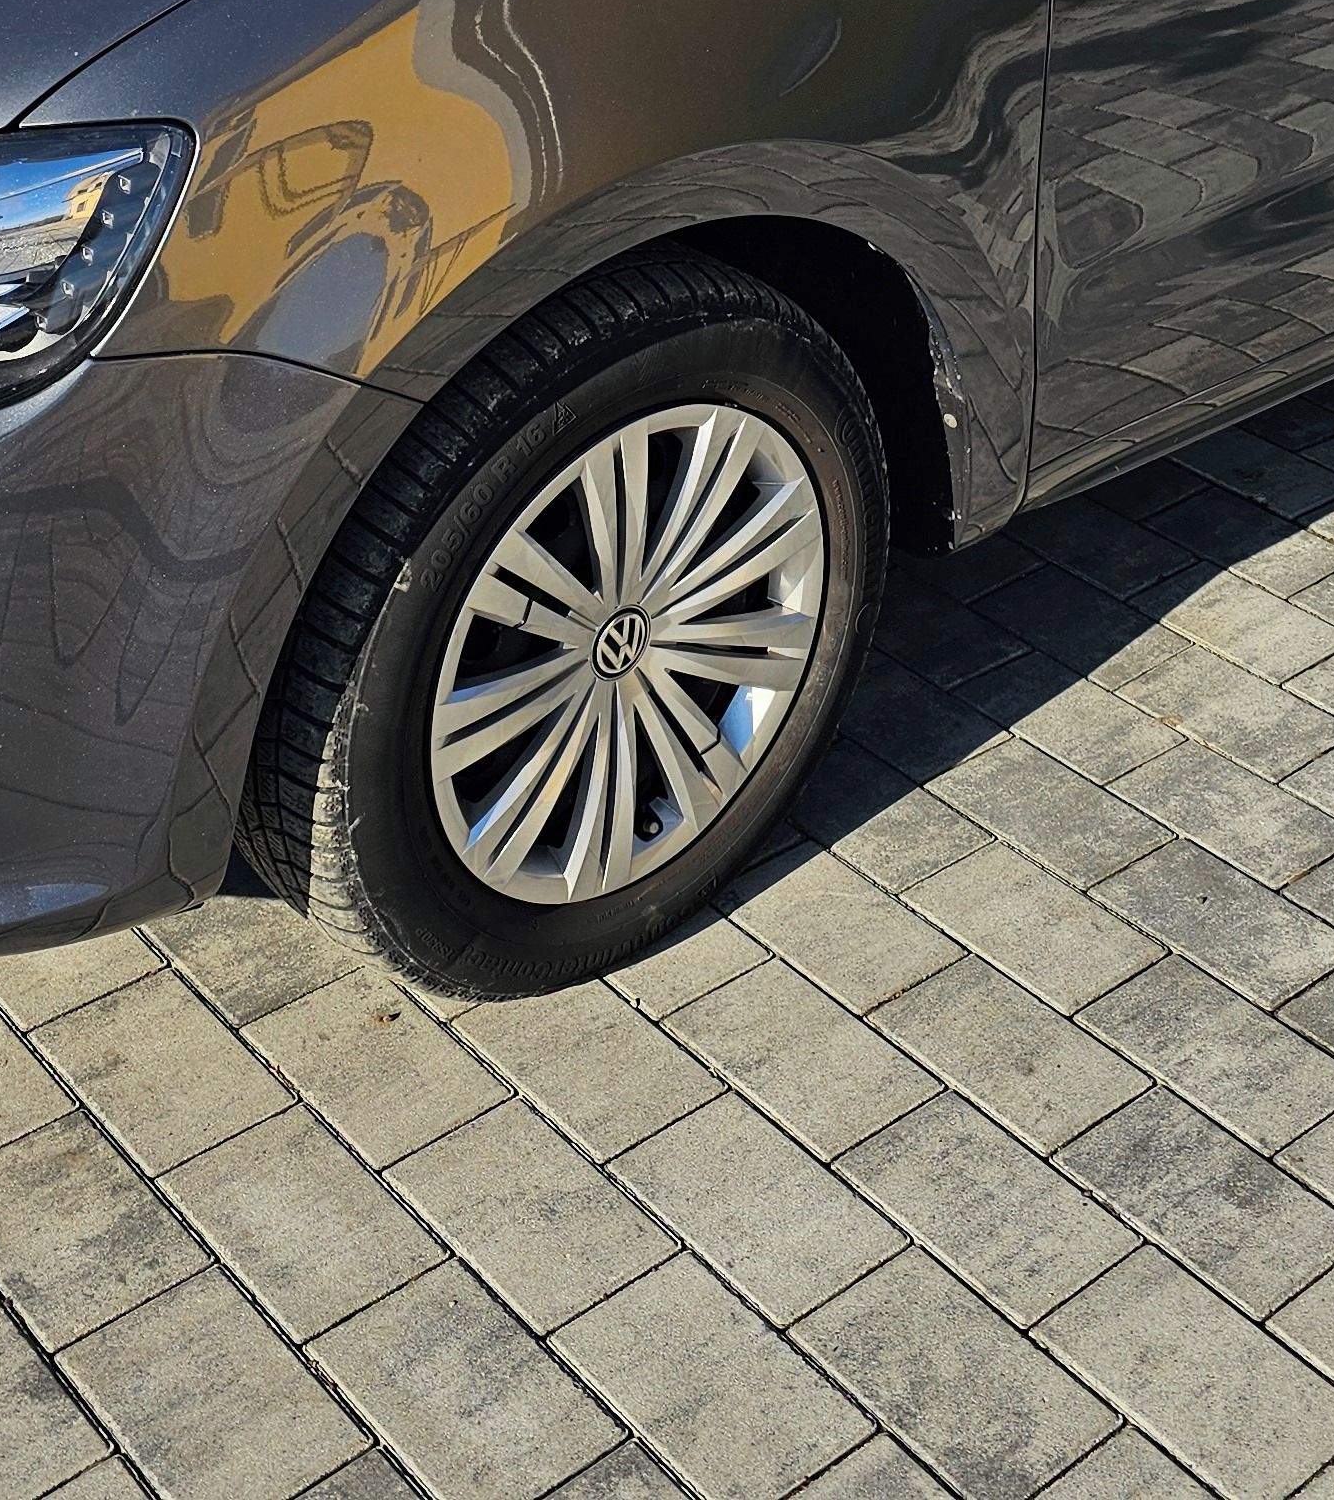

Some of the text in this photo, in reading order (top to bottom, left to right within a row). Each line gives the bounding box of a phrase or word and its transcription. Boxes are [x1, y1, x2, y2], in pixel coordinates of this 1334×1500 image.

[419, 423, 546, 592] 205/60 R 16
[597, 612, 647, 674] VW
